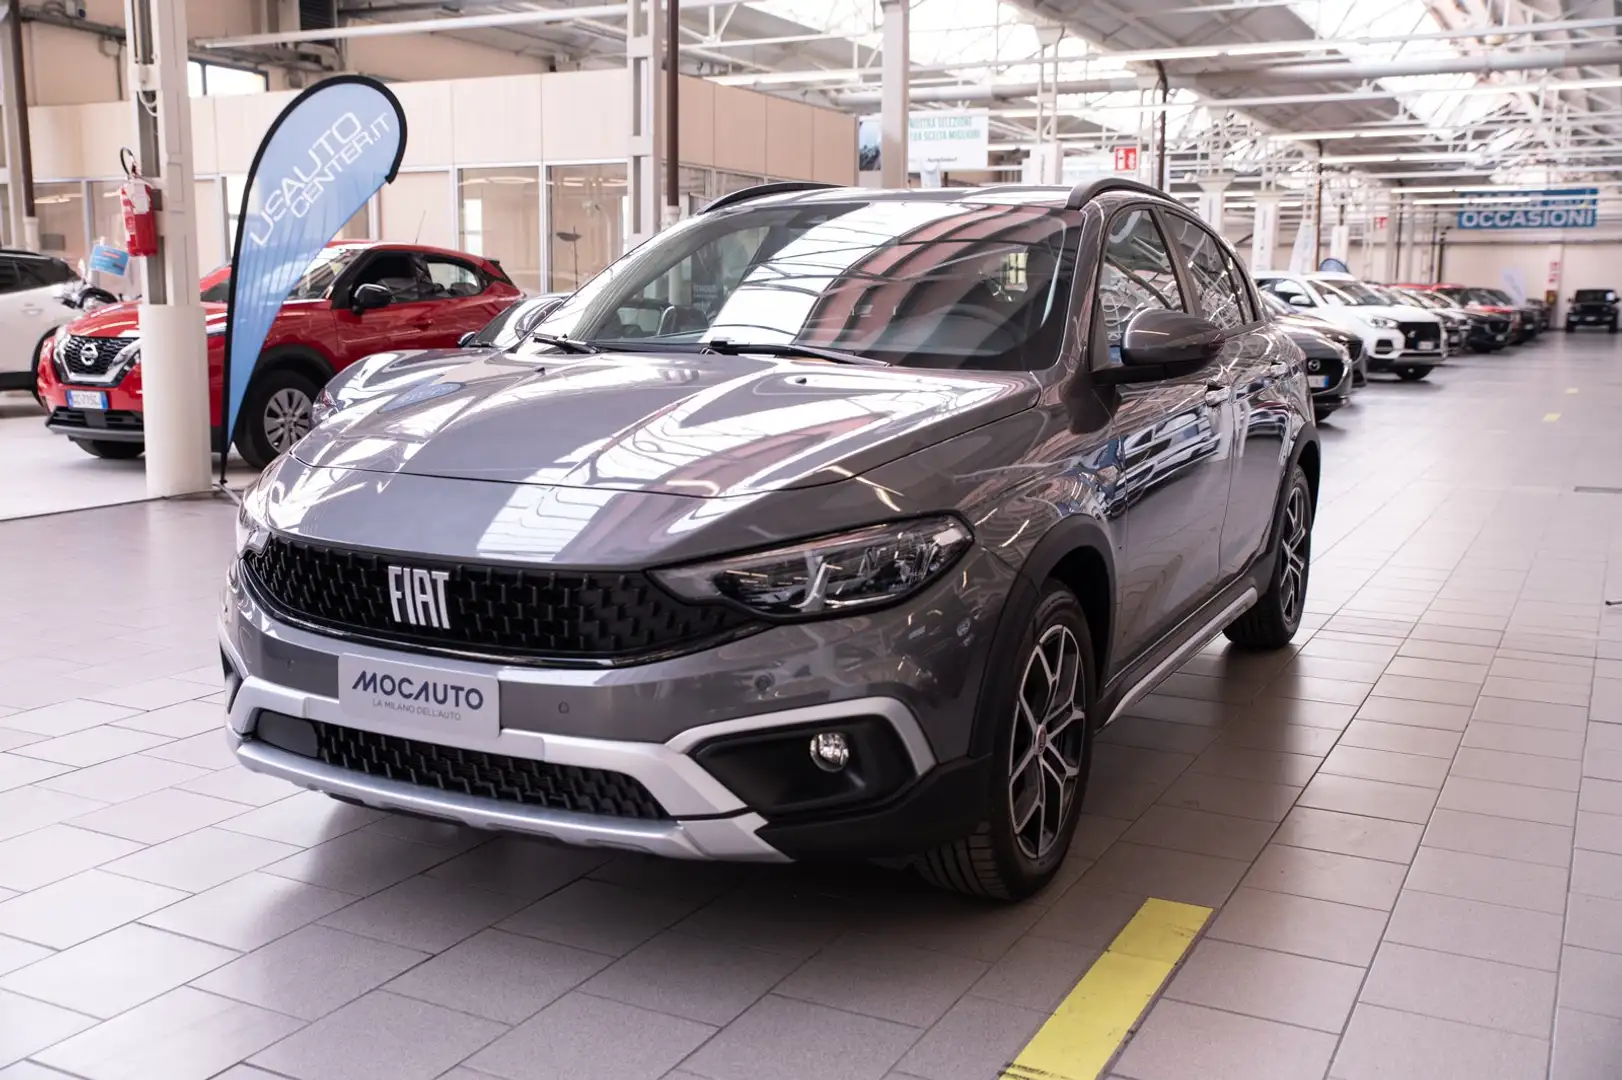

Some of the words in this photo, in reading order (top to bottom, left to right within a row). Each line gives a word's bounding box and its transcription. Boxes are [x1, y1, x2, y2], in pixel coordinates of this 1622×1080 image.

[290, 111, 389, 219] CENTER.IT
[1461, 209, 1593, 227] OCCASIONI
[388, 565, 451, 629] FIAT
[352, 670, 484, 710] MOCAUTO
[372, 698, 383, 708] LA
[384, 699, 415, 714] MILANO
[416, 706, 462, 721] DELL'AUTO
